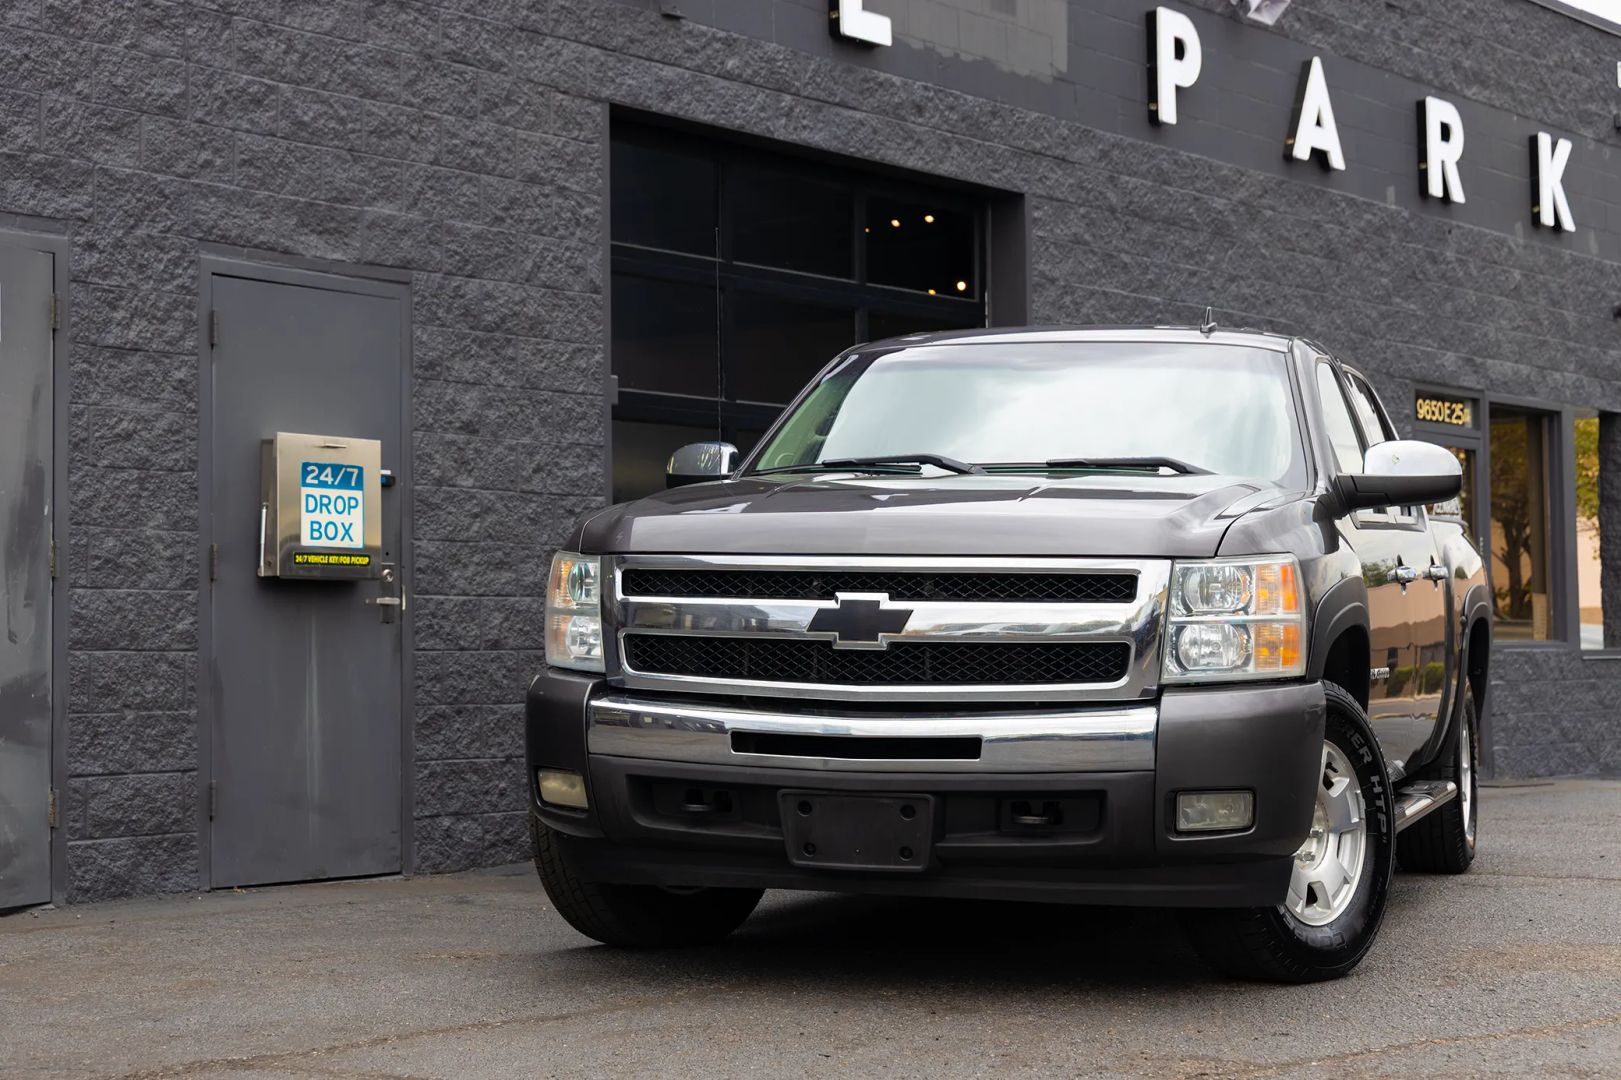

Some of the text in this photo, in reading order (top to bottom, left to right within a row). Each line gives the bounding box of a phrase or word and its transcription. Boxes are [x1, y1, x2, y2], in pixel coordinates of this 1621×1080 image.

[1151, 7, 1576, 232] PARK
[305, 465, 359, 486] 24/7
[305, 493, 359, 515] DROP
[309, 520, 354, 542] BOX
[308, 555, 328, 564] VEHICLE
[351, 556, 369, 566] PICKUP
